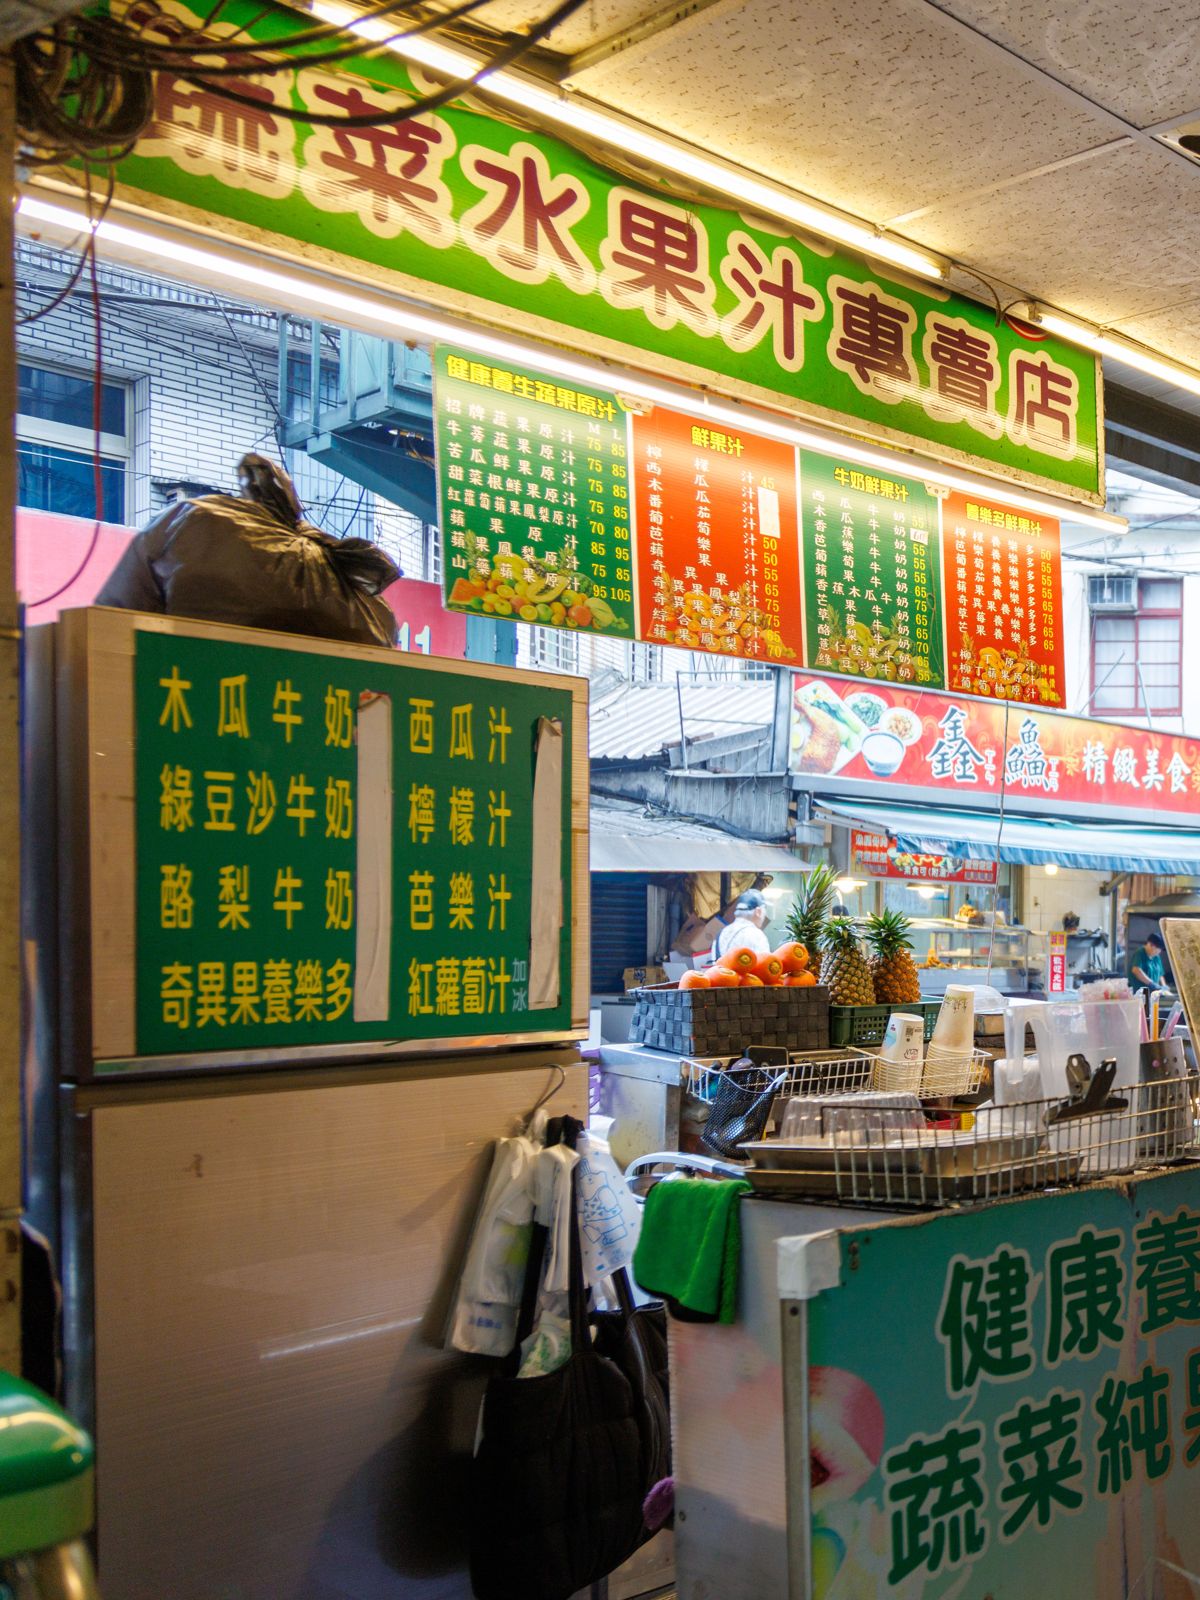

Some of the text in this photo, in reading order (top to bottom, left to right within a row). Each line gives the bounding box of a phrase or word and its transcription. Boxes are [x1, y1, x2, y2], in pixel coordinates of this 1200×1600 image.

[446, 354, 616, 422] 健康養生蔬果原汁
[586, 436, 602, 451] 75
[611, 443, 625, 458] 85
[587, 422, 622, 440] M L
[691, 425, 744, 457] 鮮果汁
[446, 420, 626, 479] 牛蒡蔬果原汁 75 85
[447, 442, 627, 499] 苦瓜鮮果原汁 75 85
[646, 462, 755, 499] 西瓜汁
[760, 476, 774, 489] 45
[834, 467, 909, 502] 牛奶鮮果汁
[448, 464, 628, 520] 甜菜根鮮果原汁 75 85
[647, 478, 756, 515] 木瓜汁
[648, 494, 756, 530] 番茄汁
[649, 509, 778, 550] 葡萄汁 50
[814, 505, 906, 537] 木瓜牛奶
[912, 516, 924, 528] 55
[450, 508, 629, 562] 蘋果原汁 85 95
[589, 520, 605, 535] 70
[614, 526, 629, 541] 80
[649, 525, 778, 566] 芭樂汁 50
[814, 520, 925, 556] 香蕉牛奶 55
[451, 530, 631, 582] 蘋果鳳梨原汁 75 85
[650, 543, 778, 581] 蘋果汁 55
[814, 534, 926, 570] 芭樂牛奶 55
[815, 549, 926, 584] 葡萄牛奶 55
[452, 553, 631, 603] 山藥蘋果原汁 95 105
[651, 559, 778, 597] 奇異果汁 65
[652, 576, 779, 612] 奇異果鳳梨汁 75
[815, 563, 927, 598] 蘋果牛奶 65
[816, 578, 927, 612] 香蕉木瓜牛奶 75
[653, 591, 780, 627] 奇異果香蕉汁 75
[817, 593, 928, 626] 芒果牛奶 65
[818, 608, 928, 640] 草莓牛奶 65
[767, 629, 780, 642] 65
[769, 644, 782, 657] 70
[818, 624, 929, 654] 酪梨牛奶 70
[917, 656, 929, 668] 65
[918, 669, 930, 681] 55
[159, 666, 352, 749] 木瓜牛奶
[408, 698, 512, 764] 西瓜汁
[1081, 740, 1191, 793] 精緻美食
[159, 763, 352, 839] 綠豆沙牛奶
[408, 784, 512, 847] 檸檬汁
[160, 863, 352, 930] 酪梨牛奶
[408, 870, 512, 930] 芭樂汁
[160, 959, 352, 1029] 奇異果養樂多
[408, 956, 512, 1016] 紅蘿蔔汁
[512, 957, 527, 1012] 加冰
